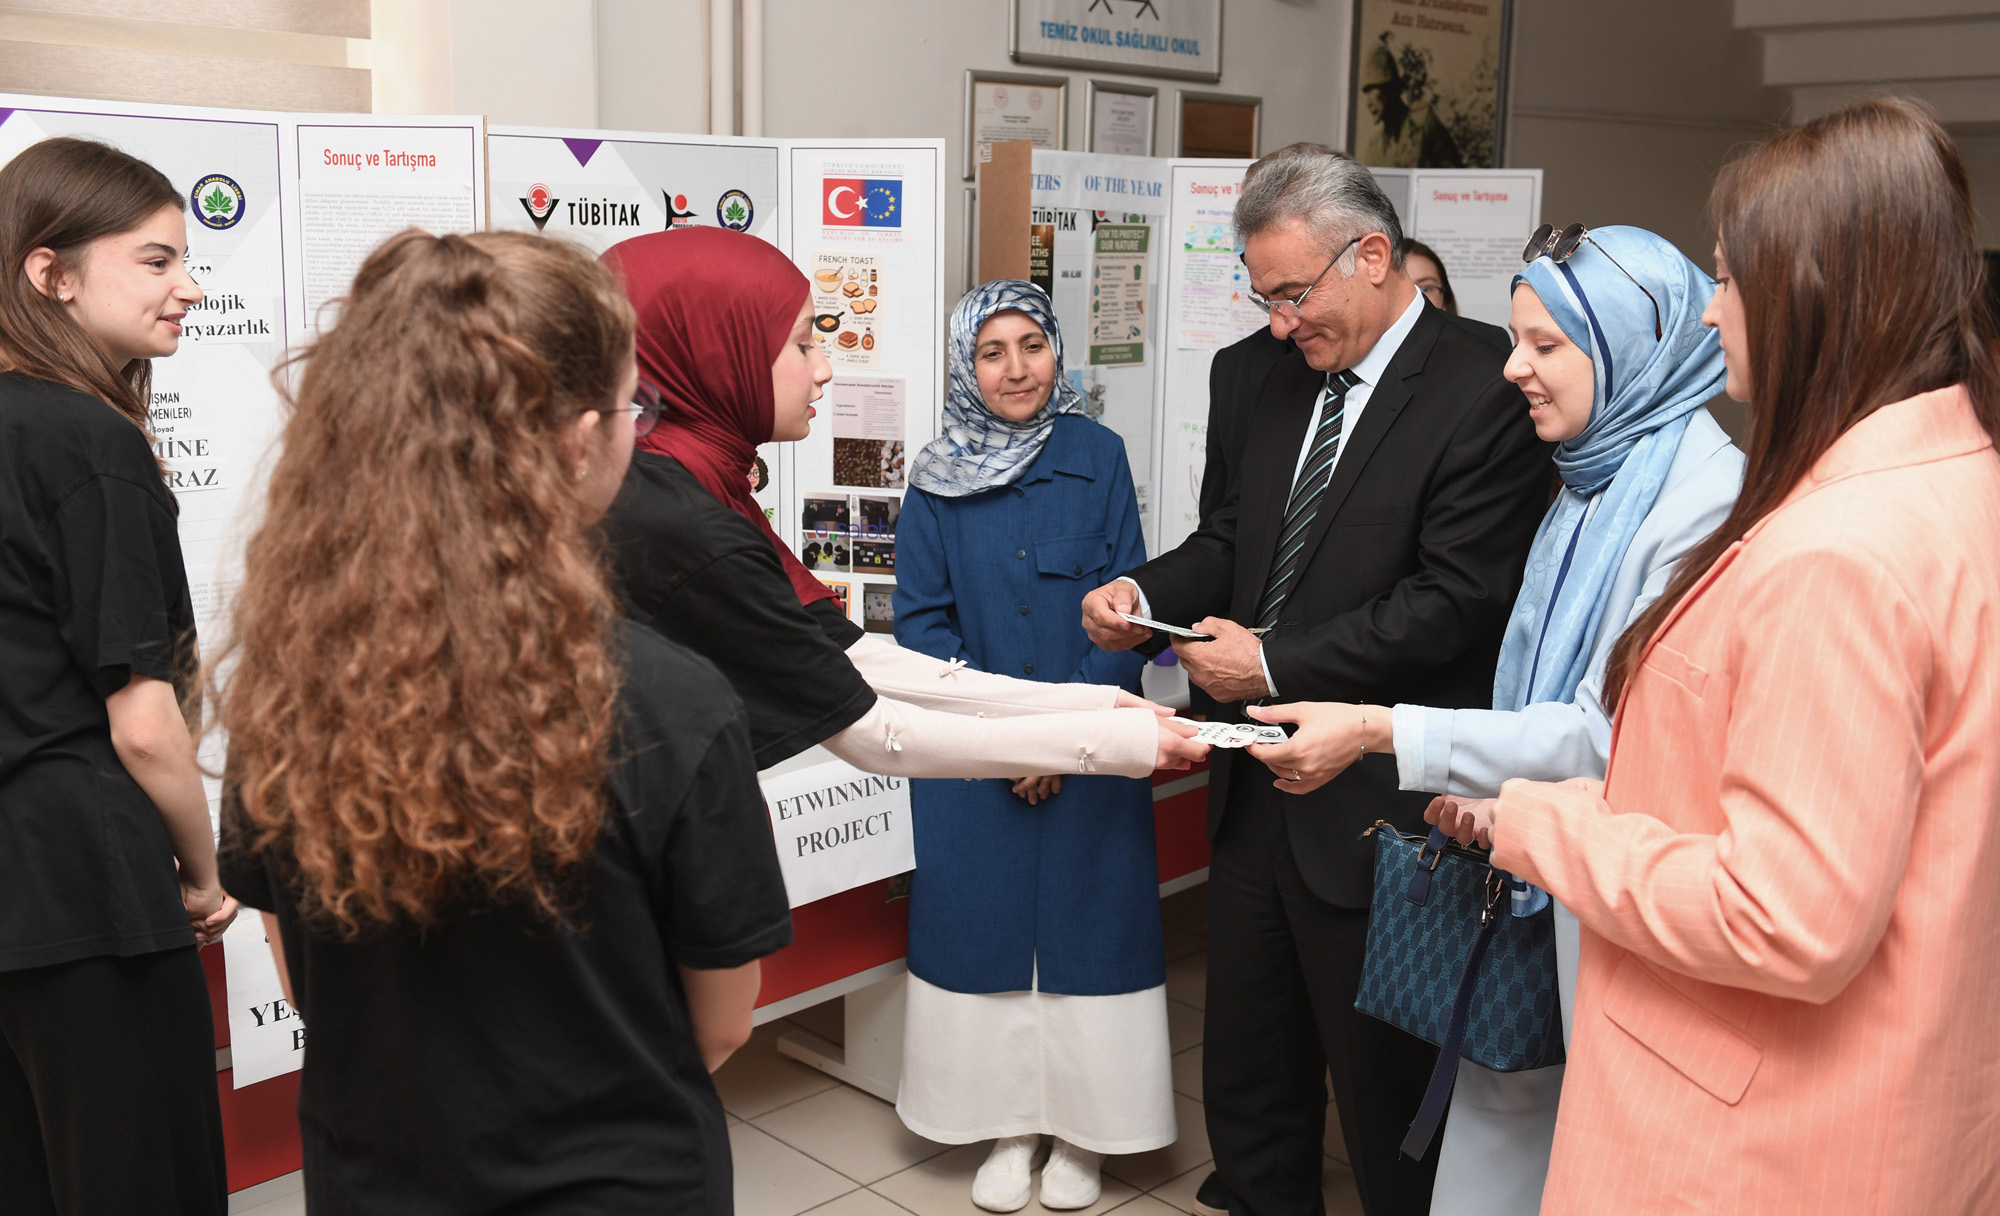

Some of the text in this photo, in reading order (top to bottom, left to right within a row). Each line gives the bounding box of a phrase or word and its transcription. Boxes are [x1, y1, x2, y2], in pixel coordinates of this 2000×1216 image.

[1040, 20, 1200, 56] TEMİZ OKUL SAĞLIKLI OKUL
[323, 148, 436, 172] Sonuç ve Tartışma
[1085, 175, 1102, 191] OF
[1104, 177, 1128, 194] THE
[1130, 180, 1162, 197] YEAR
[1191, 182, 1218, 198] Sonuç
[1222, 186, 1232, 195] ve
[1433, 190, 1458, 204] Sonuç
[1473, 190, 1508, 204] Tartışma
[568, 198, 640, 226] TÜBİTAK
[819, 255, 874, 264] FRENCH TOAST
[777, 775, 901, 821] ETWINNING
[796, 811, 893, 858] PROJECT
